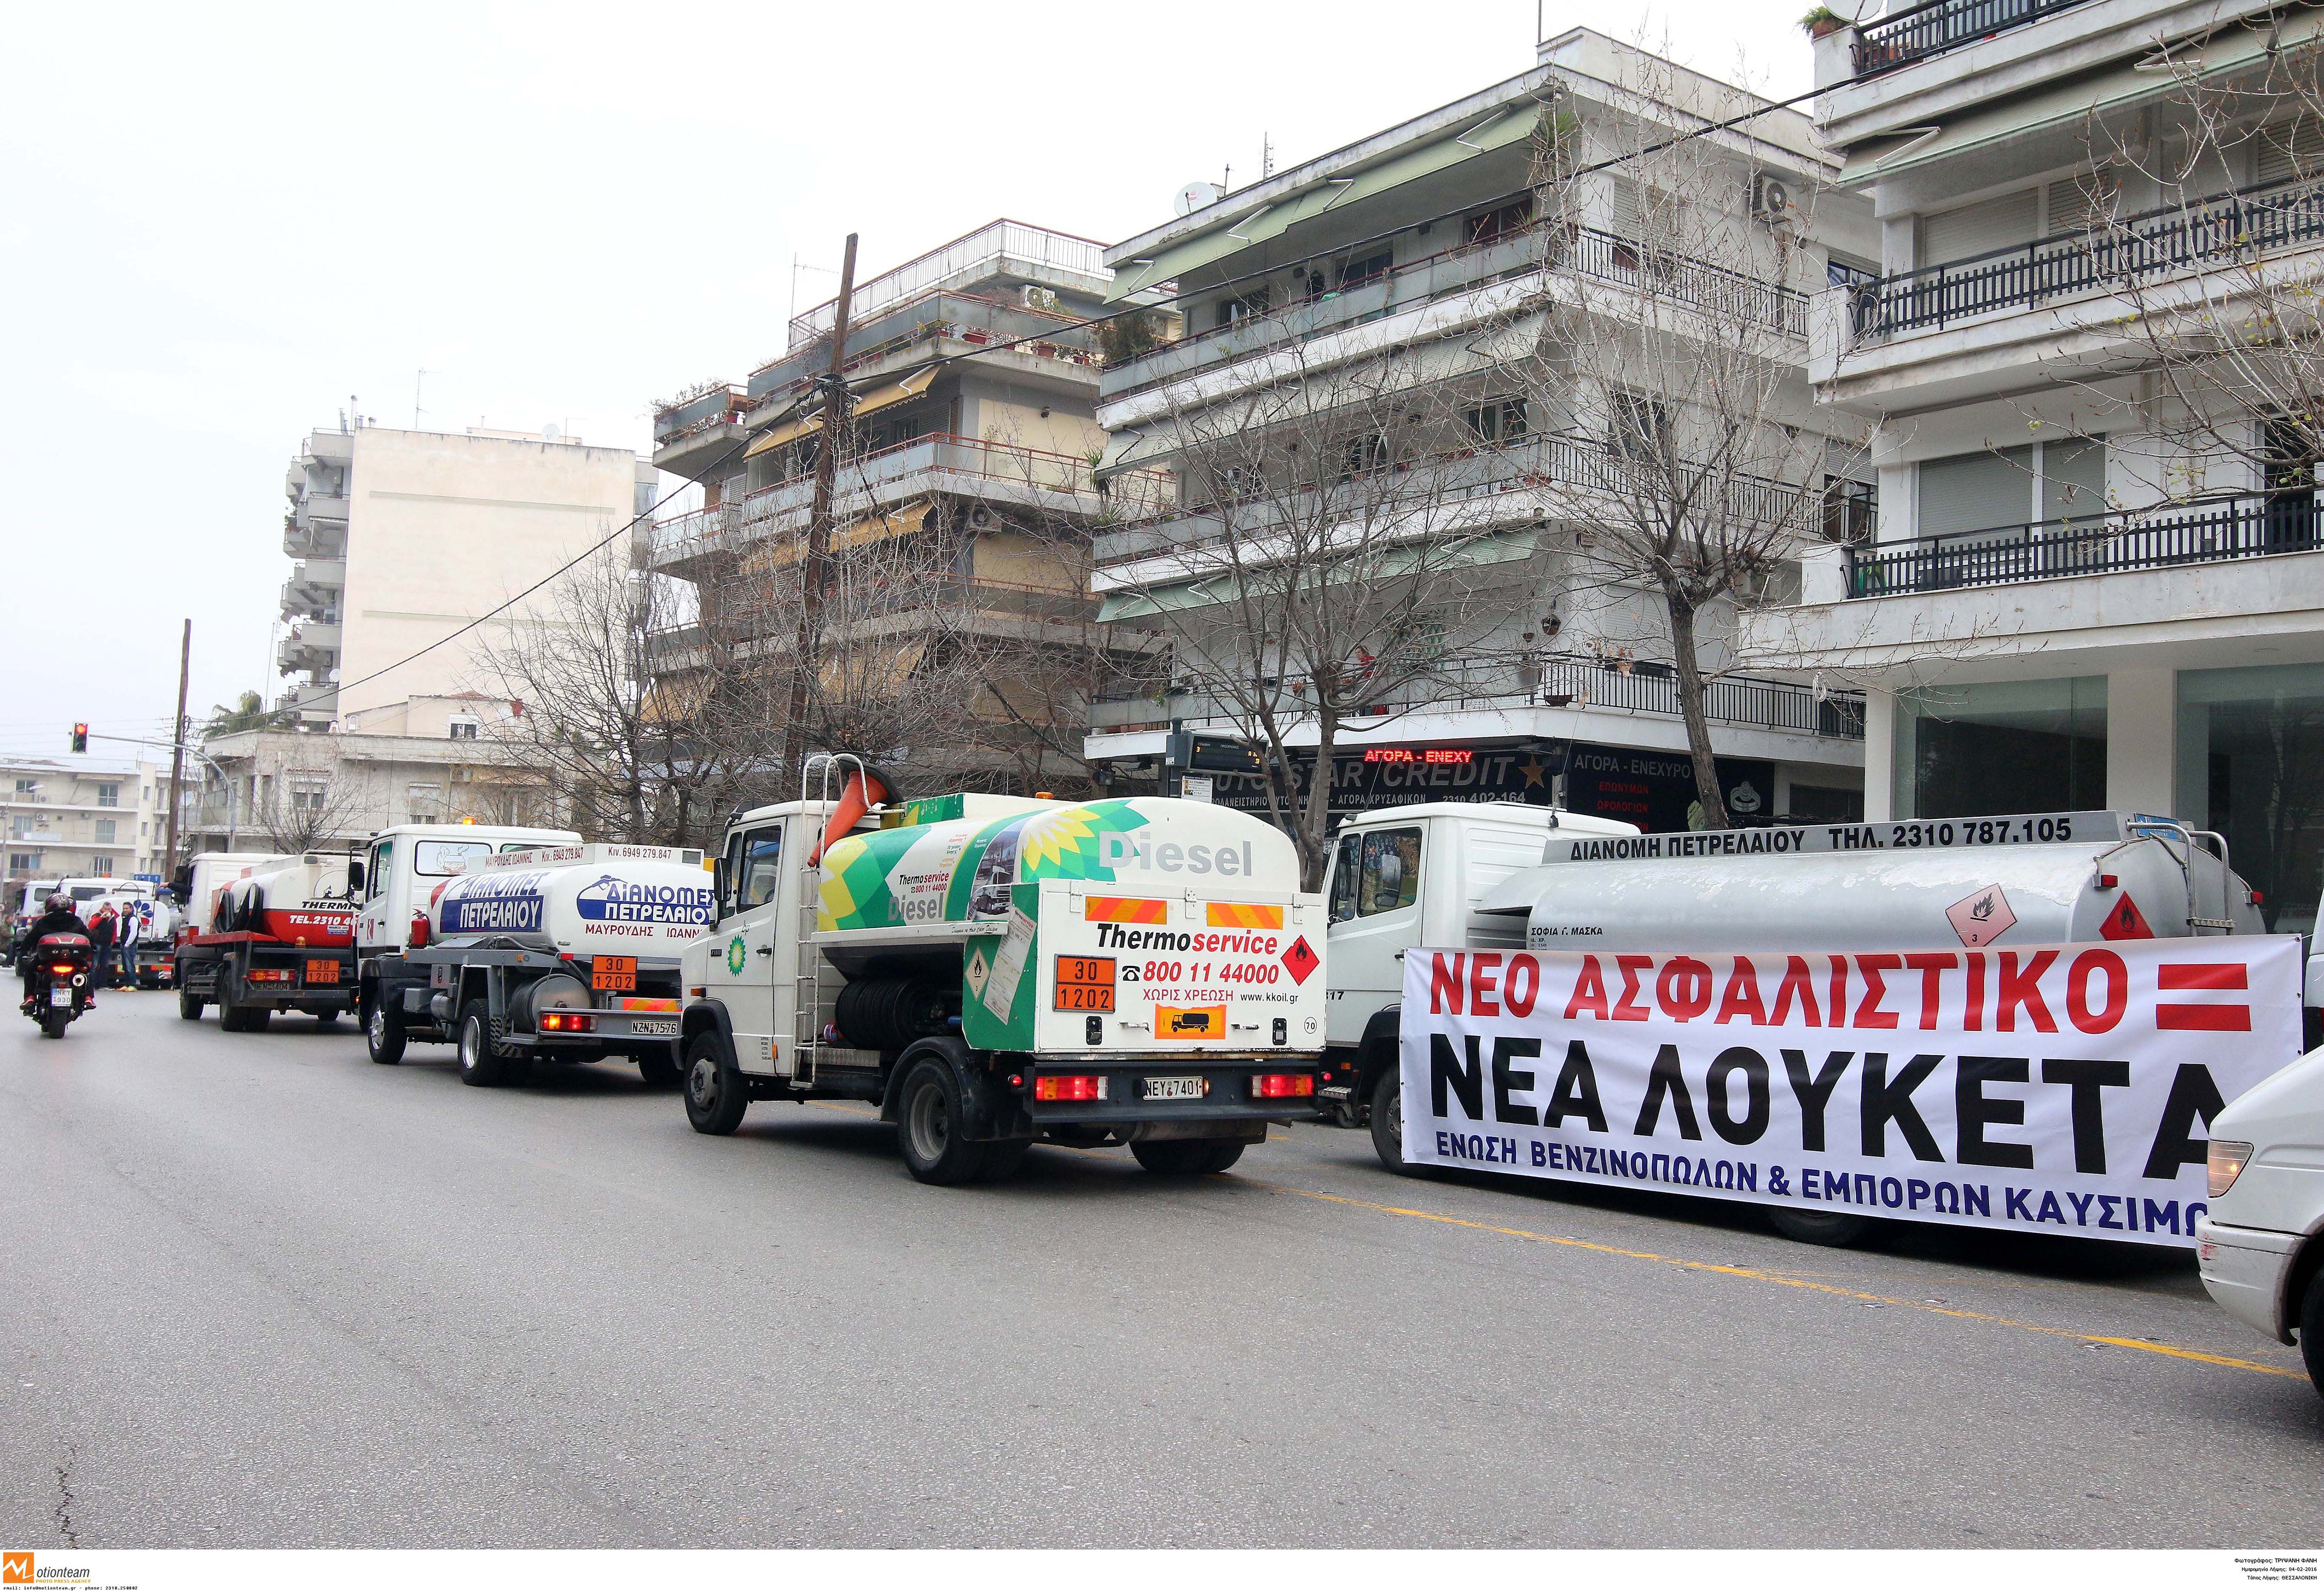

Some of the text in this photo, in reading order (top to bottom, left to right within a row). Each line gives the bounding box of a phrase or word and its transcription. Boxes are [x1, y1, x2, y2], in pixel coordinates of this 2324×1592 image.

[1365, 749, 1414, 762] ΑΓΟΡΑ
[1425, 750, 1473, 763] ΕΝΕΧΥ
[1383, 757, 1515, 787] CREDIT
[1574, 754, 1620, 772] ΑΓΟΡΑ
[1631, 758, 1691, 779] ΕΝΕΧΥΡΟ
[1599, 781, 1649, 794] ΕΠΩΝΥΜΩΝ
[1338, 794, 1365, 804] ΑΓΟΡΑ
[1368, 794, 1426, 804] ΧΡΥΣΑΦΙΚΩΝ
[1469, 792, 1526, 803] 402-164
[1597, 800, 1649, 813] ΩΡΟΛΟΓΙΩΝ
[1828, 818, 2072, 850] ΤΗΛ. 2310 787.105
[608, 846, 672, 859] Κιν. 6949 279.847
[1570, 830, 1806, 861] ΔΙΑΝΟΜΗ ΠΕΤΡΕΛΑΙΟΥ
[485, 853, 512, 867] ΜΑΥΡΟΥΔΗΣ
[512, 852, 533, 865] ΙΩΑΝΝΗΣ
[553, 850, 564, 861] 6949
[565, 847, 583, 860] 279.847
[1100, 831, 1252, 876] Diesel
[899, 870, 949, 885] Thermoservice
[915, 885, 924, 893] 800
[932, 883, 947, 891] 44000
[460, 900, 540, 928] ΠΕΤΡΕΛΑΙΟΥ
[888, 893, 944, 921] Diesel
[290, 915, 341, 925] TEL.2310
[741, 920, 750, 935] bp
[585, 924, 702, 939] ΜΑΥΡΟΥΔΗΣ ΙΩΑΝΝ
[1097, 922, 1277, 955] Thermoservice
[1531, 927, 1558, 936] ΣΟΦΙΑ
[1571, 927, 1603, 935] ΜΑΣΚΑ
[1972, 934, 1978, 943] 3
[317, 961, 329, 970] 30
[606, 958, 623, 971] 30
[1075, 961, 1097, 980] 30
[309, 973, 336, 982] 1202
[1143, 961, 1279, 984] 800 11 44000
[596, 976, 631, 988] 1202
[1061, 988, 1109, 1008] 1202
[1143, 988, 1233, 1001] ΧΩΡΙΣ ΧΡΕΩΣΗ
[1240, 992, 1299, 1004] www.kkoil.gr
[1430, 953, 1540, 1018] ΝΕΟ
[1563, 949, 2128, 1034] ΑΣΦΑΛΙΣΤΙΚΟ
[1430, 1033, 2226, 1180] ΝΕΑ ΛΟΥΚΕΤΑ
[1436, 1131, 1516, 1164] ΕΝΩΣΗ
[1531, 1141, 1757, 1192] ΒΕΝΖΙΝΟΠΩΛΩΝ
[1768, 1164, 1791, 1197] &
[1802, 1169, 1990, 1217] ΕΜΠΟΡΩΝ
